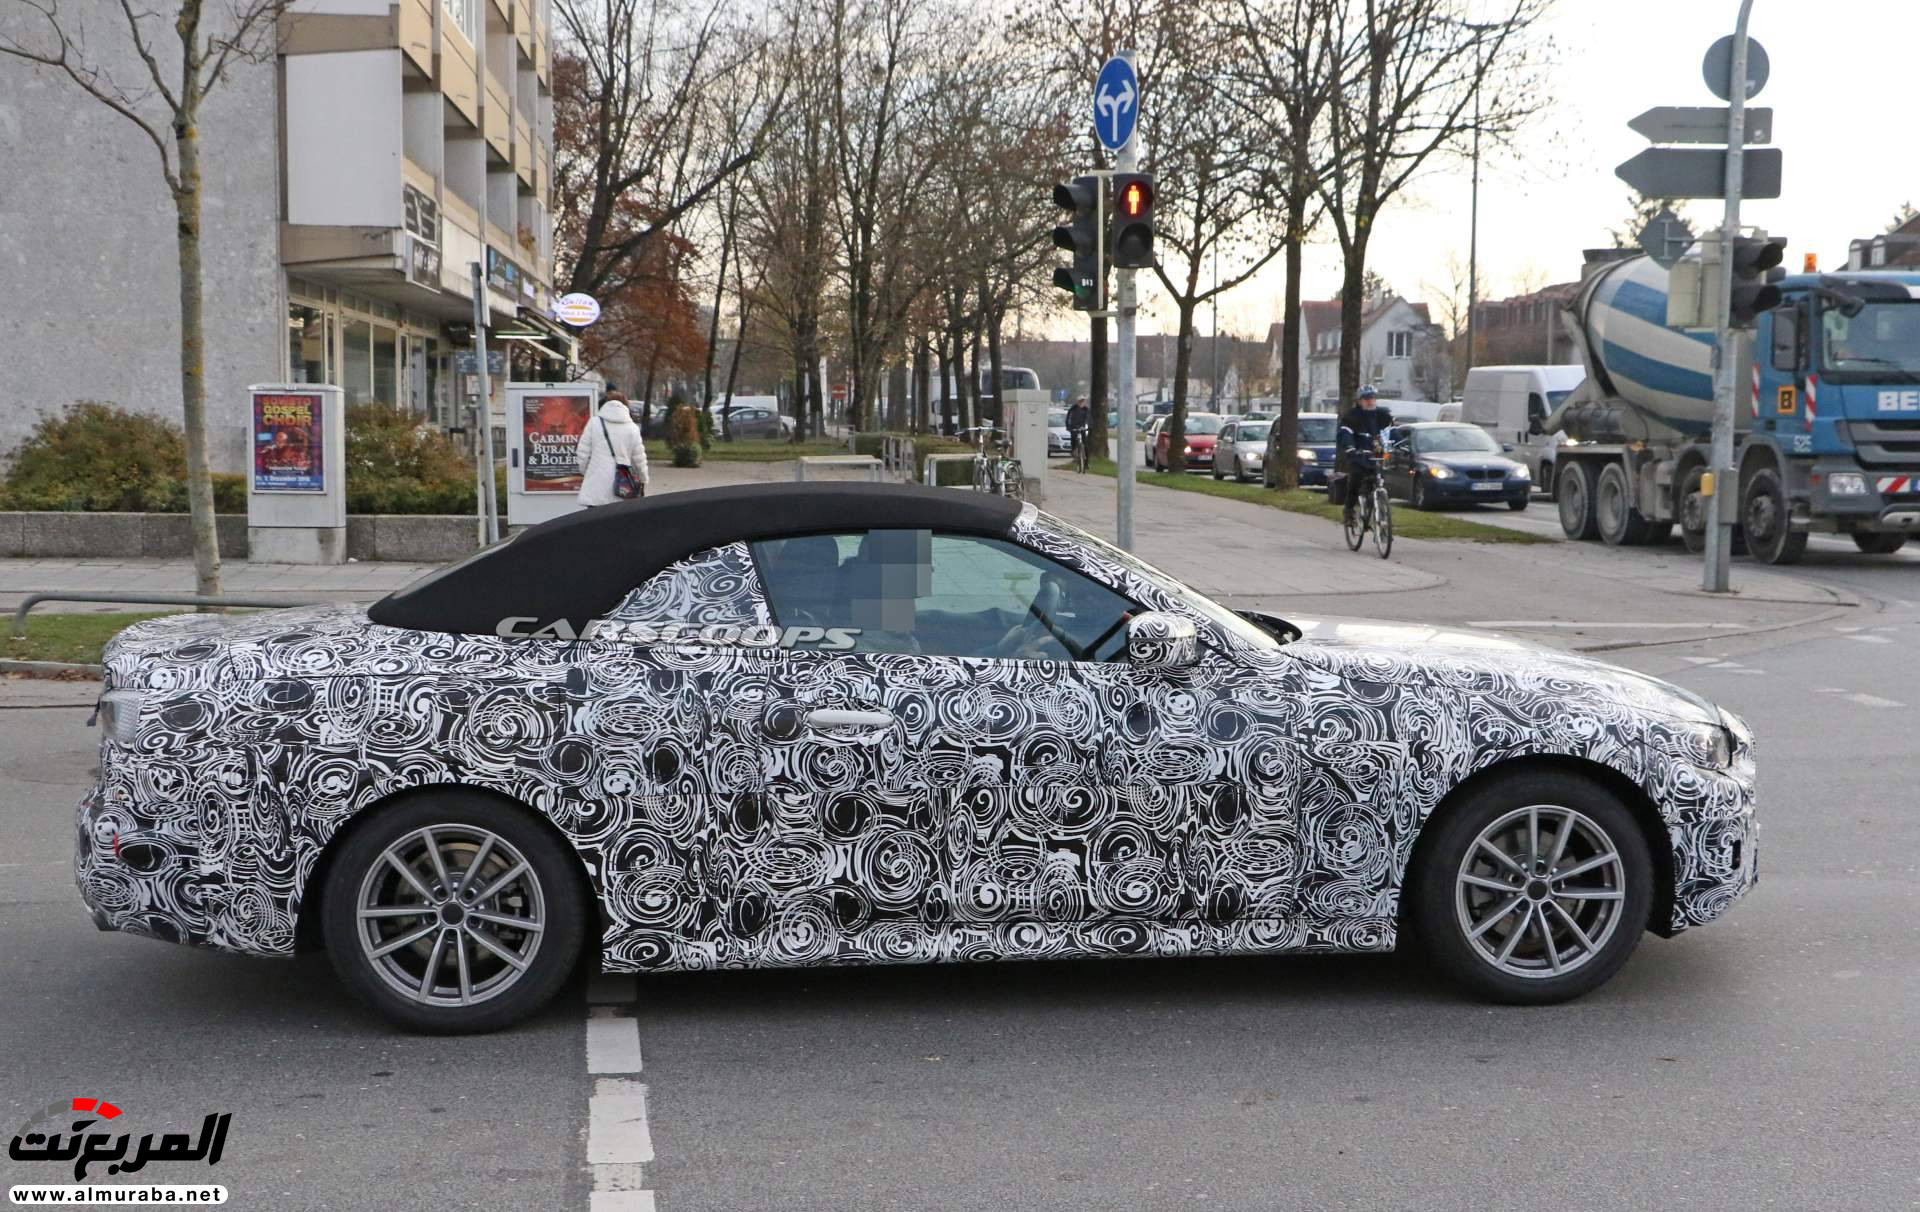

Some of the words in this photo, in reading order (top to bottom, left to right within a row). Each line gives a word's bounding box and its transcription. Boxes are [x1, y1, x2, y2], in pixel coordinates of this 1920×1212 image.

[1878, 392, 1920, 411] BE
[263, 405, 312, 415] GOSPEL
[263, 414, 312, 426] CHOIR
[529, 432, 580, 444] CARMIN
[534, 444, 577, 454] BURAN
[528, 455, 538, 465] &
